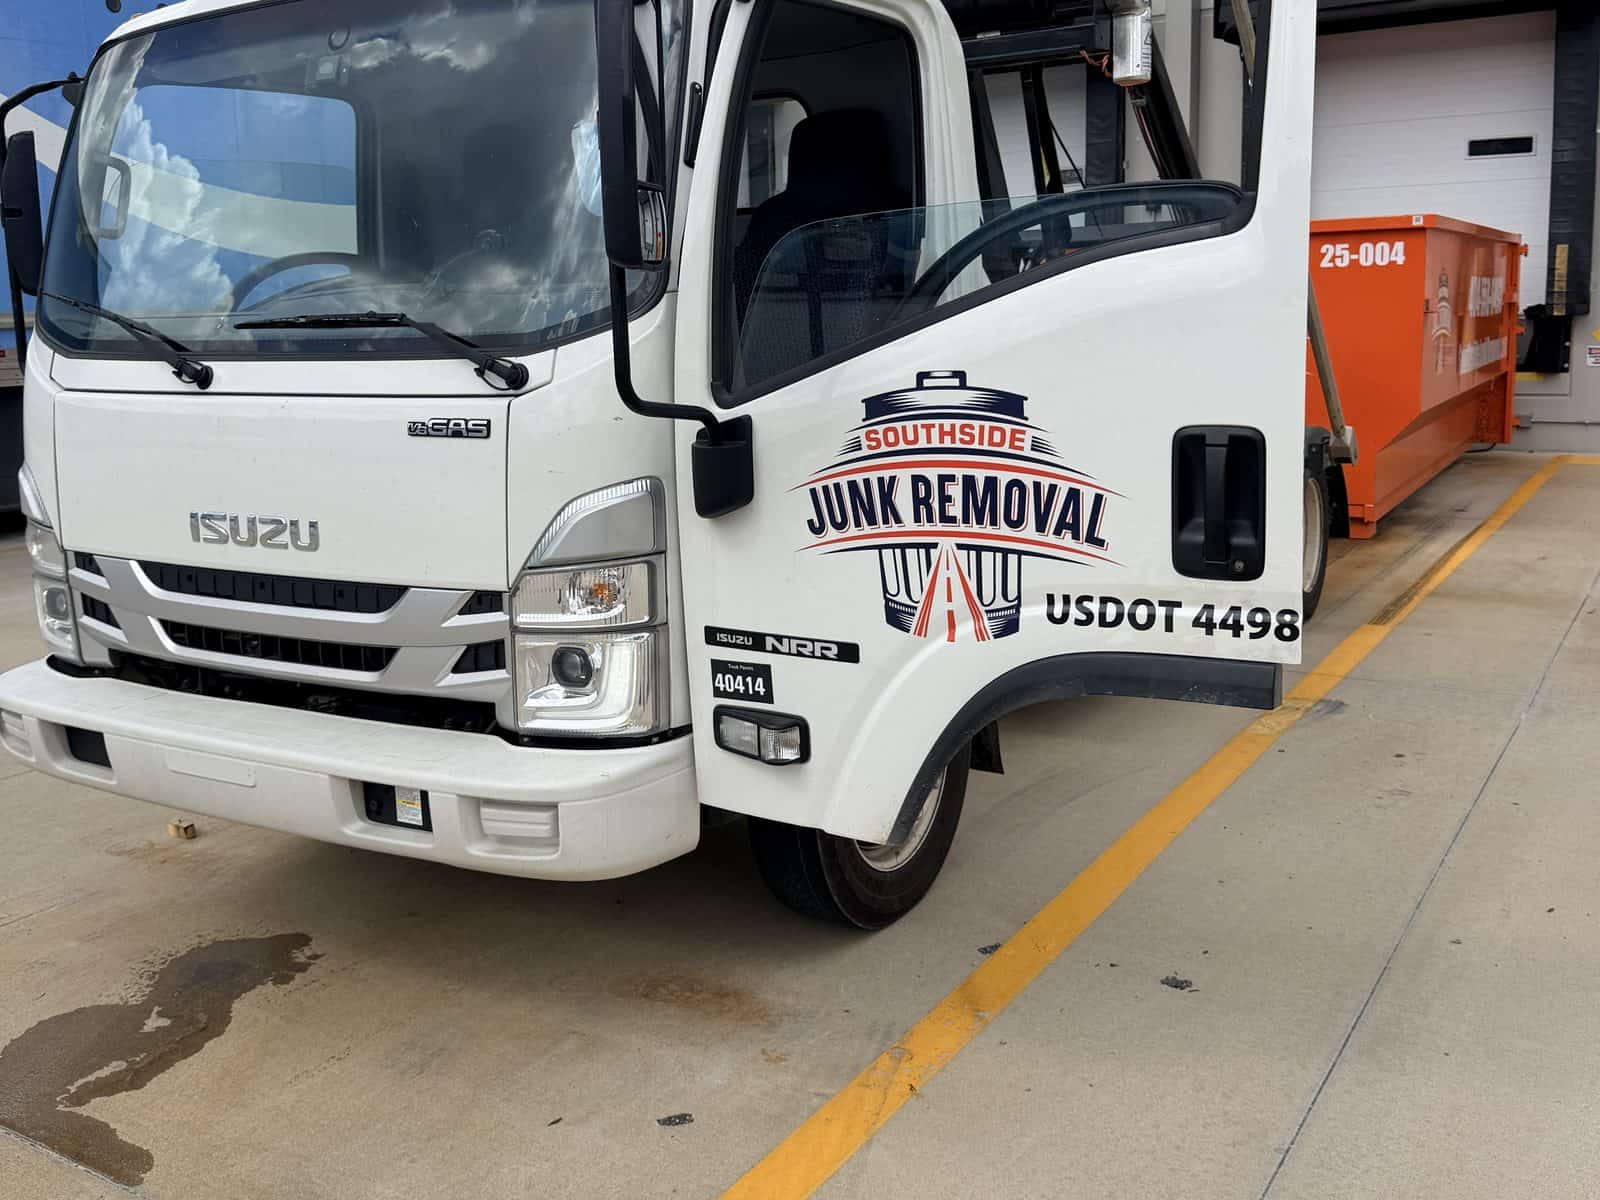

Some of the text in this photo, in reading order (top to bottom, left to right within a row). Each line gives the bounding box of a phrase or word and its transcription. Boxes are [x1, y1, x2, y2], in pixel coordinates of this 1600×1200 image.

[1319, 241, 1406, 268] 25-004
[864, 423, 1027, 451] SOUTHSIDE
[807, 474, 1109, 551] JUNK REMOVAL
[190, 511, 321, 553] ISUZU
[1046, 593, 1300, 642] USDOT 4498
[716, 632, 839, 659] ISUZU NRR
[715, 673, 766, 696] 40414
